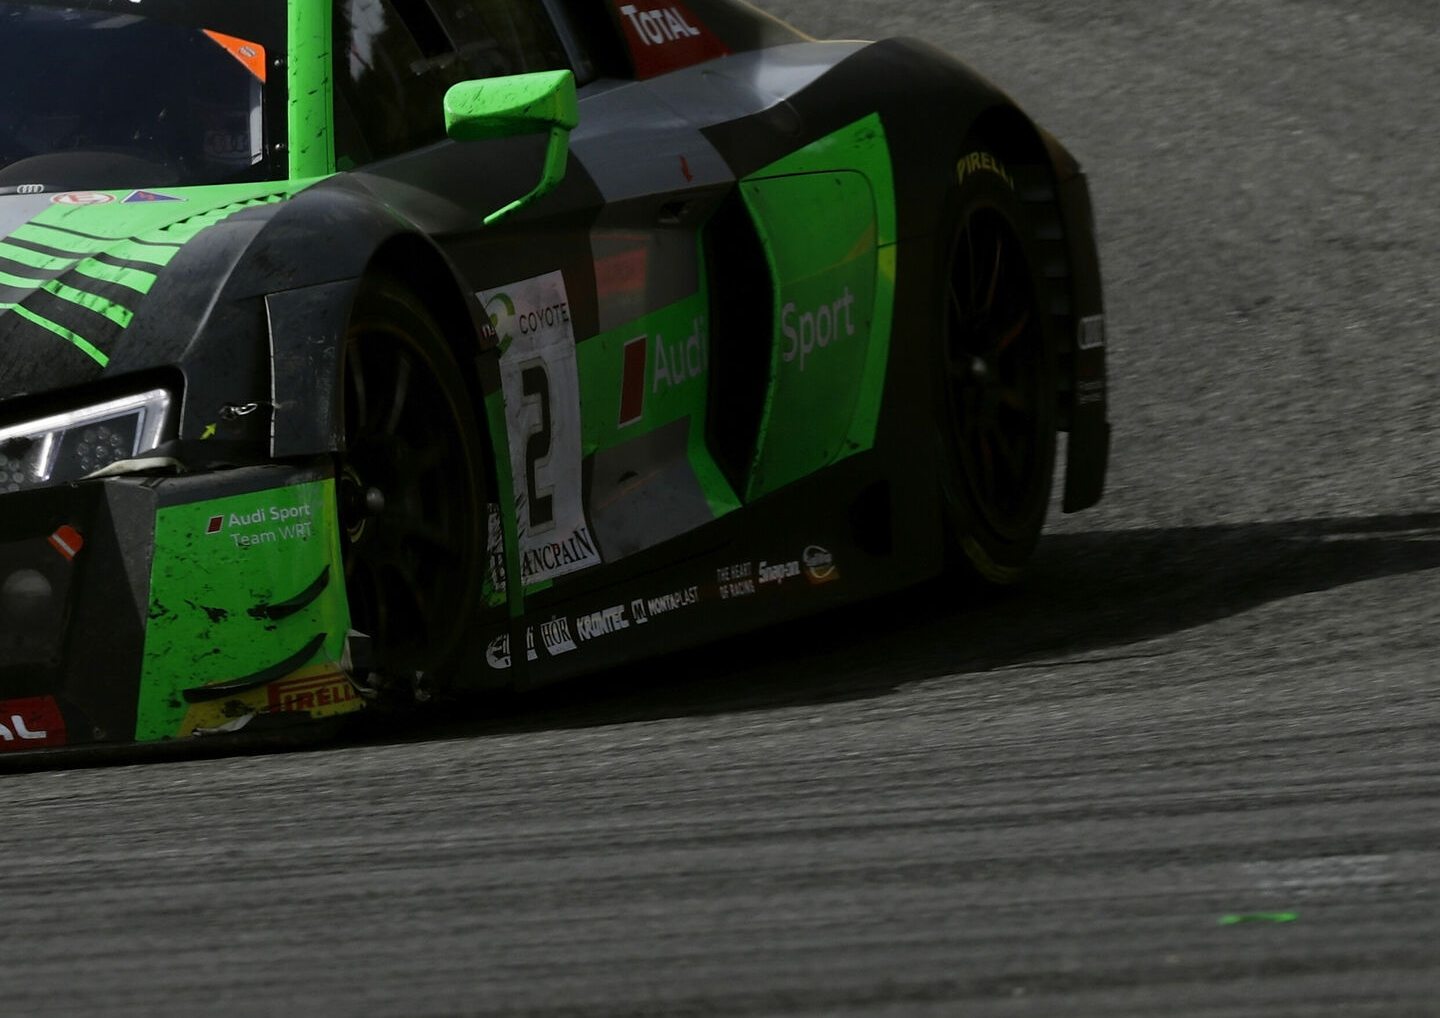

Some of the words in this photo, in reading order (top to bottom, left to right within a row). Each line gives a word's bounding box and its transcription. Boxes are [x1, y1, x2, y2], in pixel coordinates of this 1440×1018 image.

[620, 4, 701, 47] TOTAL
[519, 303, 569, 334] COYOTE
[652, 315, 709, 394] Audi
[782, 285, 856, 372] Sport
[520, 361, 556, 532] 2
[228, 508, 266, 527] Audi
[269, 503, 311, 523] Sport
[230, 531, 277, 548] Team
[278, 522, 312, 540] WRT
